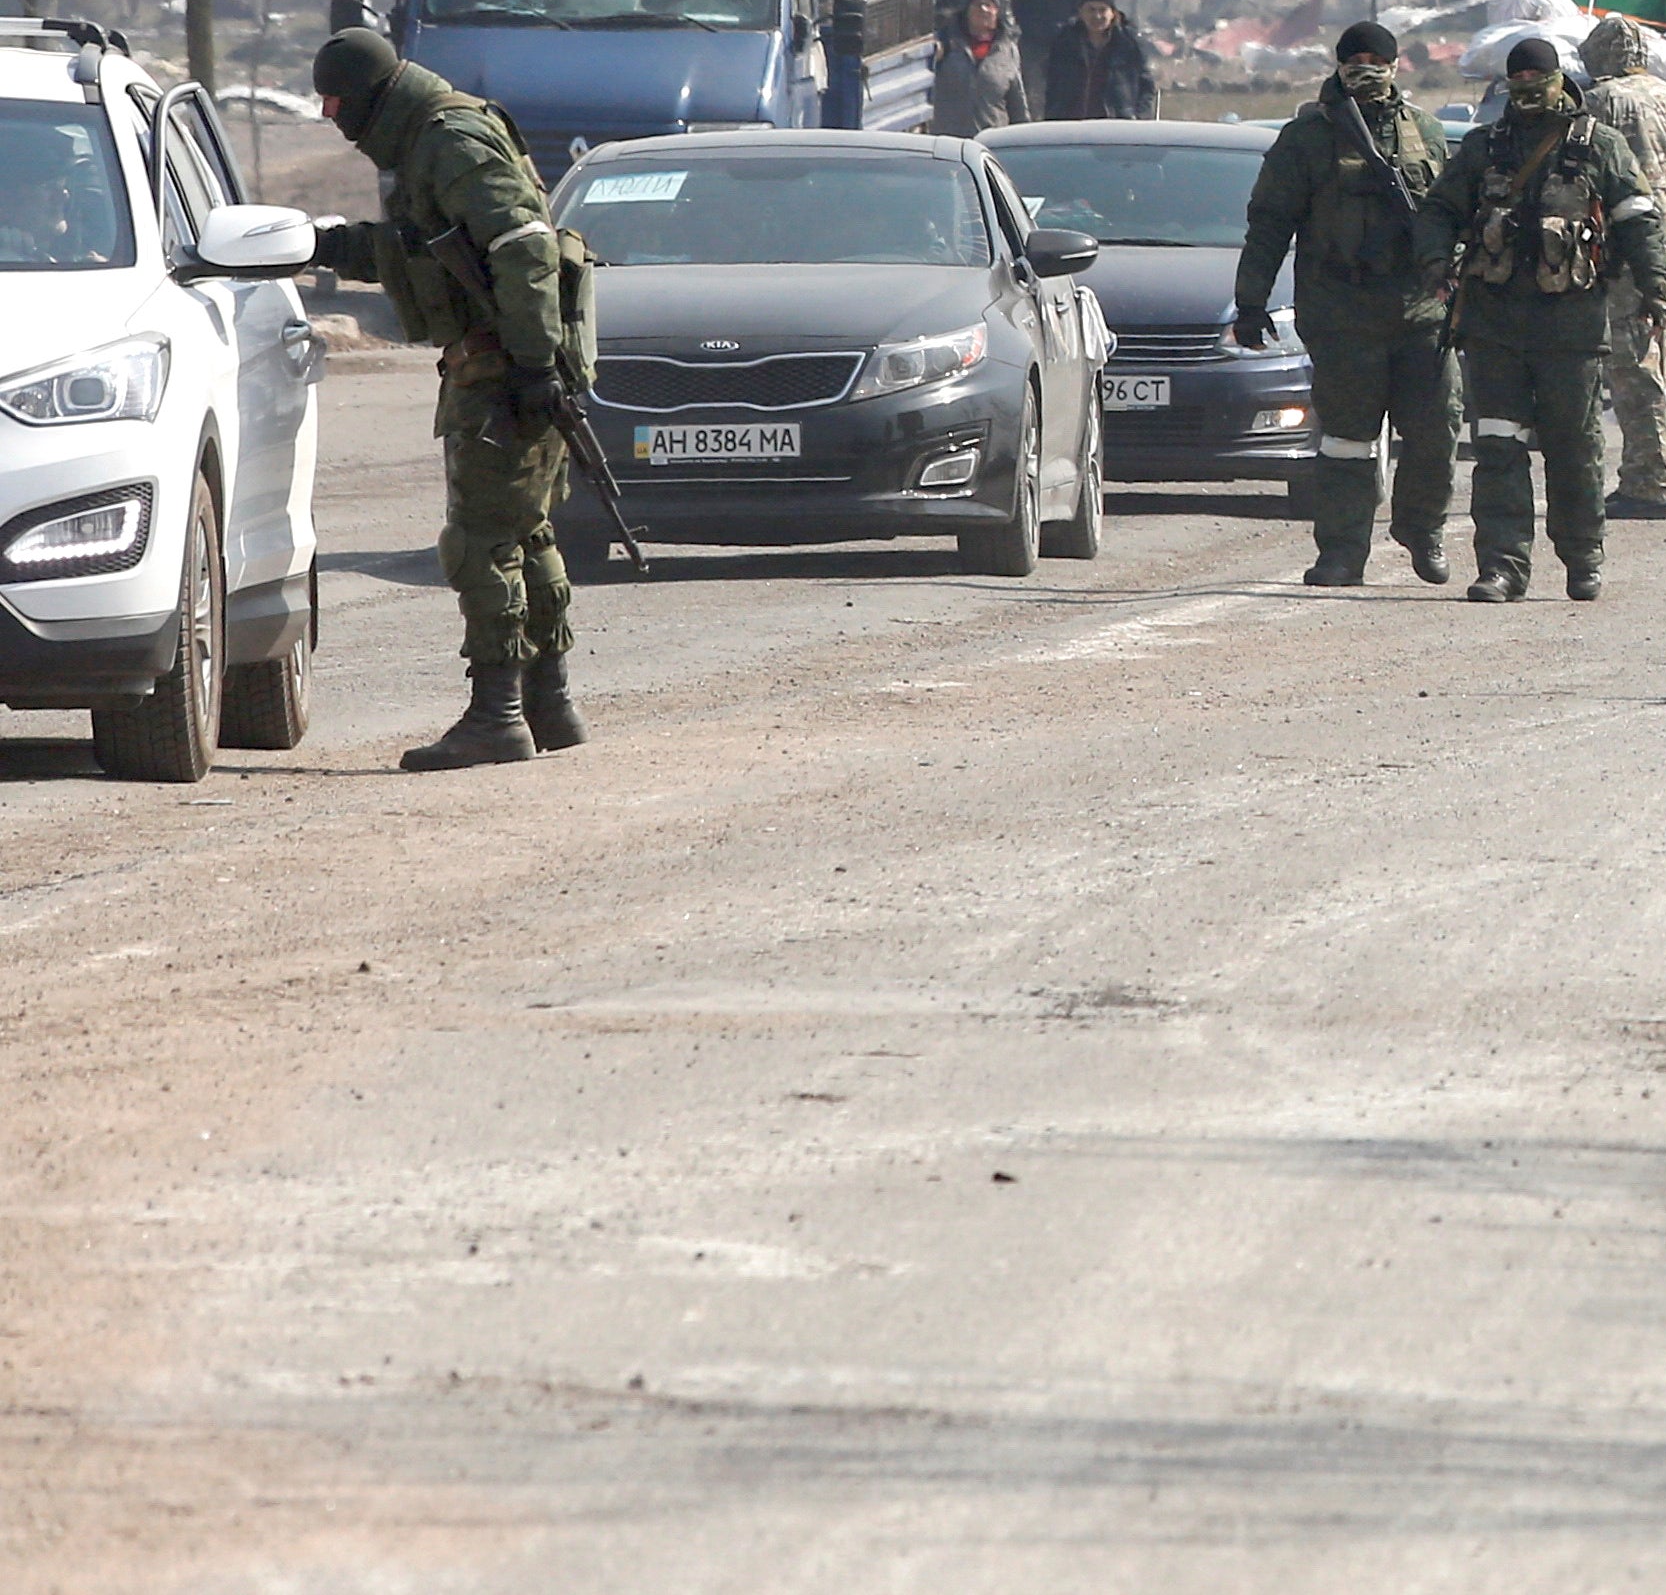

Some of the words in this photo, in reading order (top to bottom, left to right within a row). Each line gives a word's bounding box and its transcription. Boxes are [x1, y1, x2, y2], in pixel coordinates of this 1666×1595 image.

[706, 341, 732, 349] KIA
[1103, 380, 1127, 401] 96
[1133, 380, 1165, 401] CT
[652, 430, 687, 454] AH
[695, 429, 751, 453] 8384
[760, 429, 795, 453] MA
